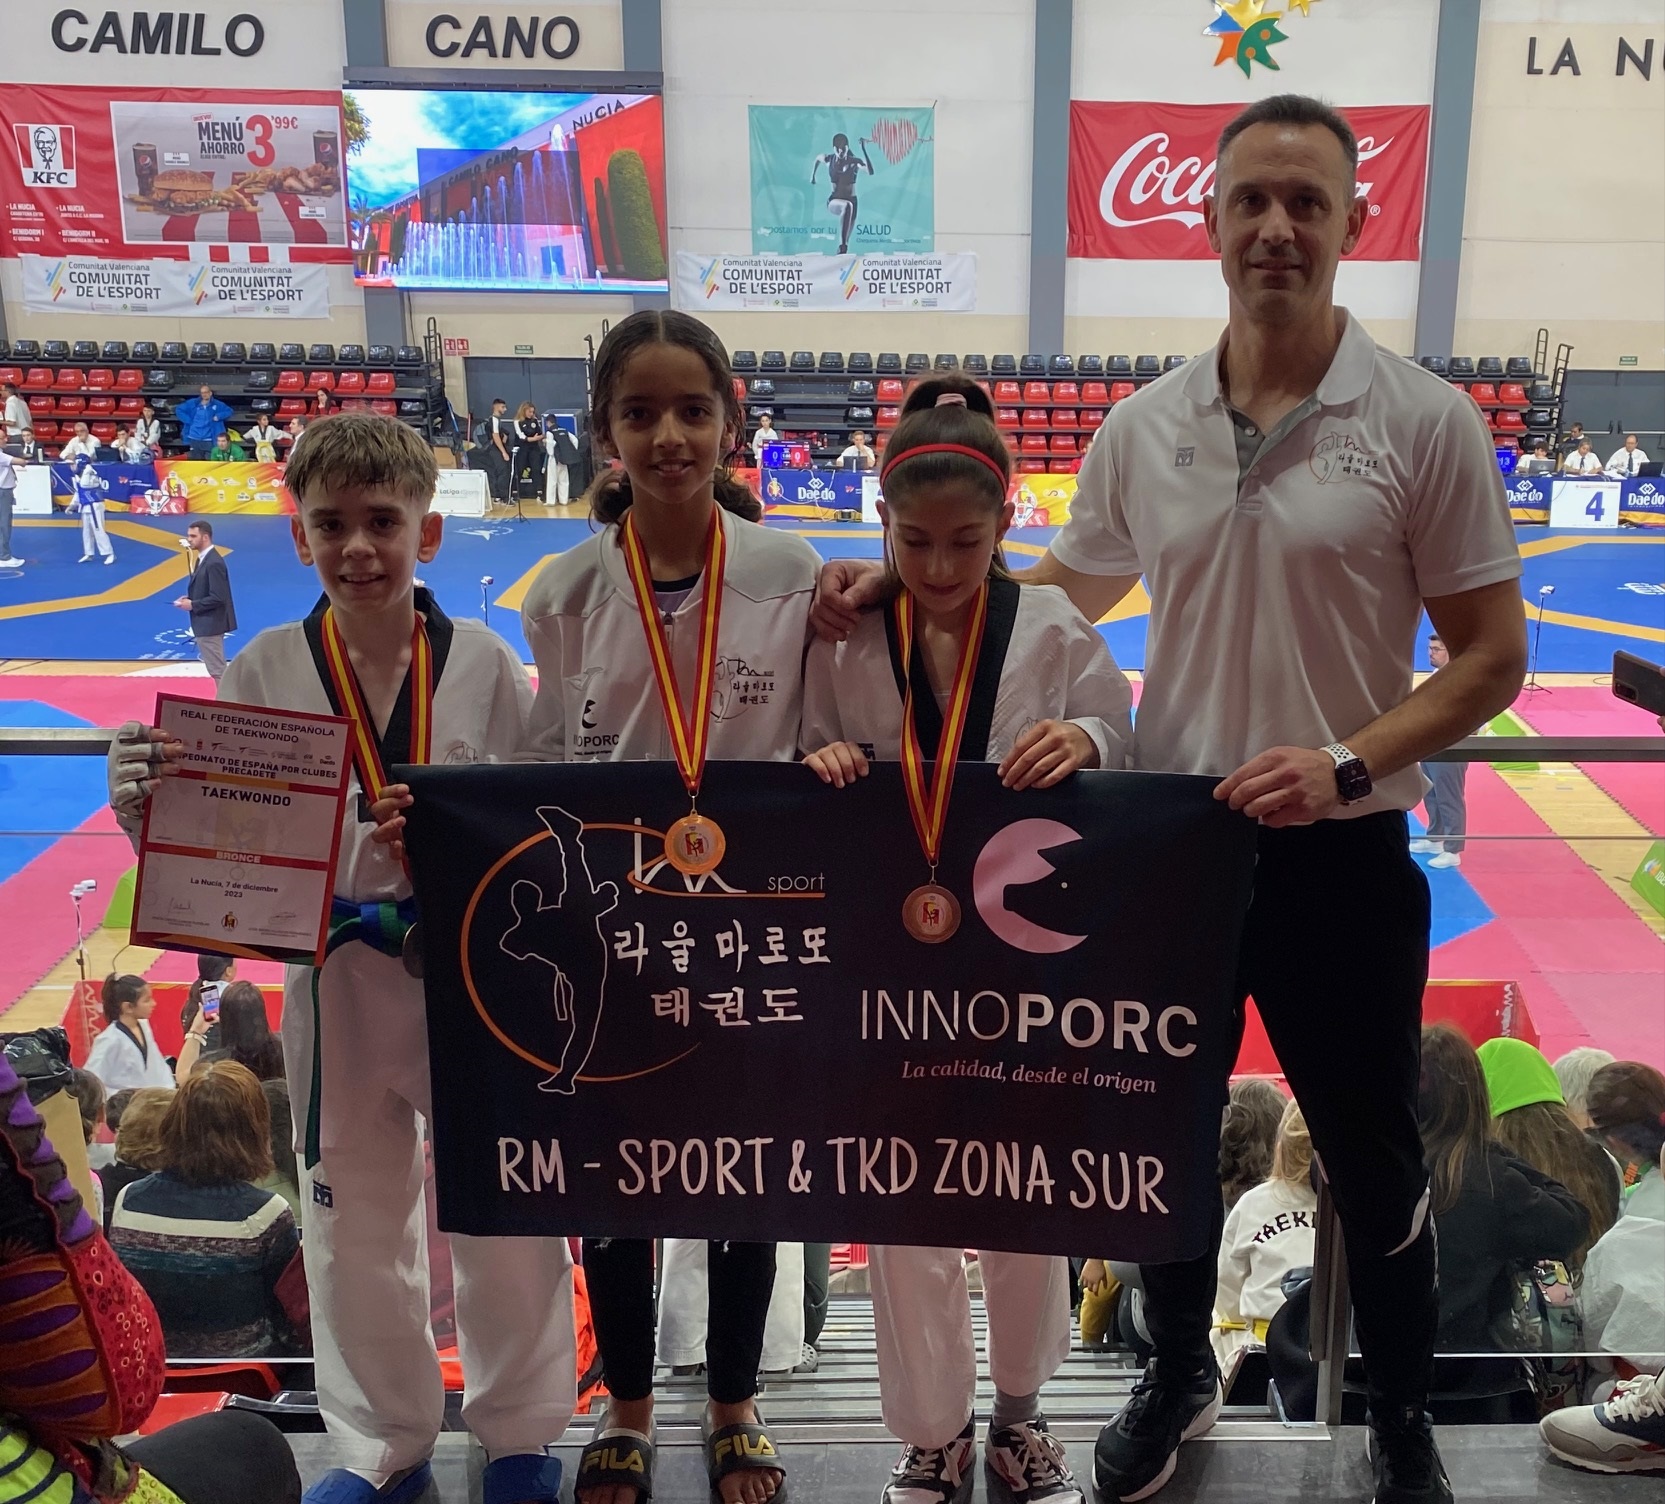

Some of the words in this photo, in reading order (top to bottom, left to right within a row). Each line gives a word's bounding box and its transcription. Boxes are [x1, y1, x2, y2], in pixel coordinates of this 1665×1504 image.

[52, 9, 264, 57] CAMILO
[426, 14, 580, 59] CANO
[1527, 37, 1581, 76] LA
[1616, 36, 1665, 81] N
[572, 99, 624, 130] NUCIA
[198, 116, 244, 141] MENÚ
[200, 142, 245, 154] AHORRO
[32, 171, 68, 184] KFC
[857, 225, 891, 236] SALUD
[68, 262, 108, 271] Comunitat
[109, 263, 150, 271] Valenciana
[723, 258, 762, 266] Comunitat
[862, 258, 901, 266] Comunitat
[902, 258, 942, 266] Valenciana
[211, 266, 251, 274] Comunitat
[252, 266, 292, 274] Valenciana
[723, 268, 802, 281] COMUNITAT
[862, 268, 942, 281] COMUNITAT
[69, 272, 150, 286] COMUNITAT
[212, 276, 292, 288] COMUNITAT
[76, 286, 94, 298] DE
[218, 288, 236, 300] DE
[729, 282, 747, 294] DE
[869, 282, 887, 293] DE
[1585, 491, 1604, 521] 4
[180, 710, 208, 720] REAL
[210, 713, 278, 730] FEDERACIÓN
[281, 722, 335, 737] ESPAÑOLA
[215, 725, 229, 734] DE
[232, 727, 299, 743] TAEKWONDO
[222, 766, 276, 778] PRECADETE
[242, 760, 279, 772] ESPAÑA
[281, 765, 300, 774] POR
[301, 768, 337, 778] CLUBES
[201, 786, 291, 806] TAEKWONDO
[216, 850, 261, 864] BRONCE
[243, 882, 278, 893] diciembre
[768, 872, 825, 894] sport
[651, 986, 804, 1028] 태권도
[862, 990, 1198, 1057] INNOPORC
[902, 1061, 925, 1079] La
[930, 1060, 1006, 1082] calidad,
[1012, 1064, 1067, 1084] desde
[1072, 1067, 1089, 1085] el
[1094, 1072, 1157, 1094] origen
[497, 1136, 565, 1194] RM
[618, 1137, 774, 1195] SPORT
[788, 1139, 812, 1193] &
[826, 1136, 918, 1195] TKD
[933, 1138, 1055, 1204] ZONA
[1069, 1149, 1170, 1214] SUR
[715, 1434, 776, 1466] FILA
[582, 1448, 644, 1474] FILA
